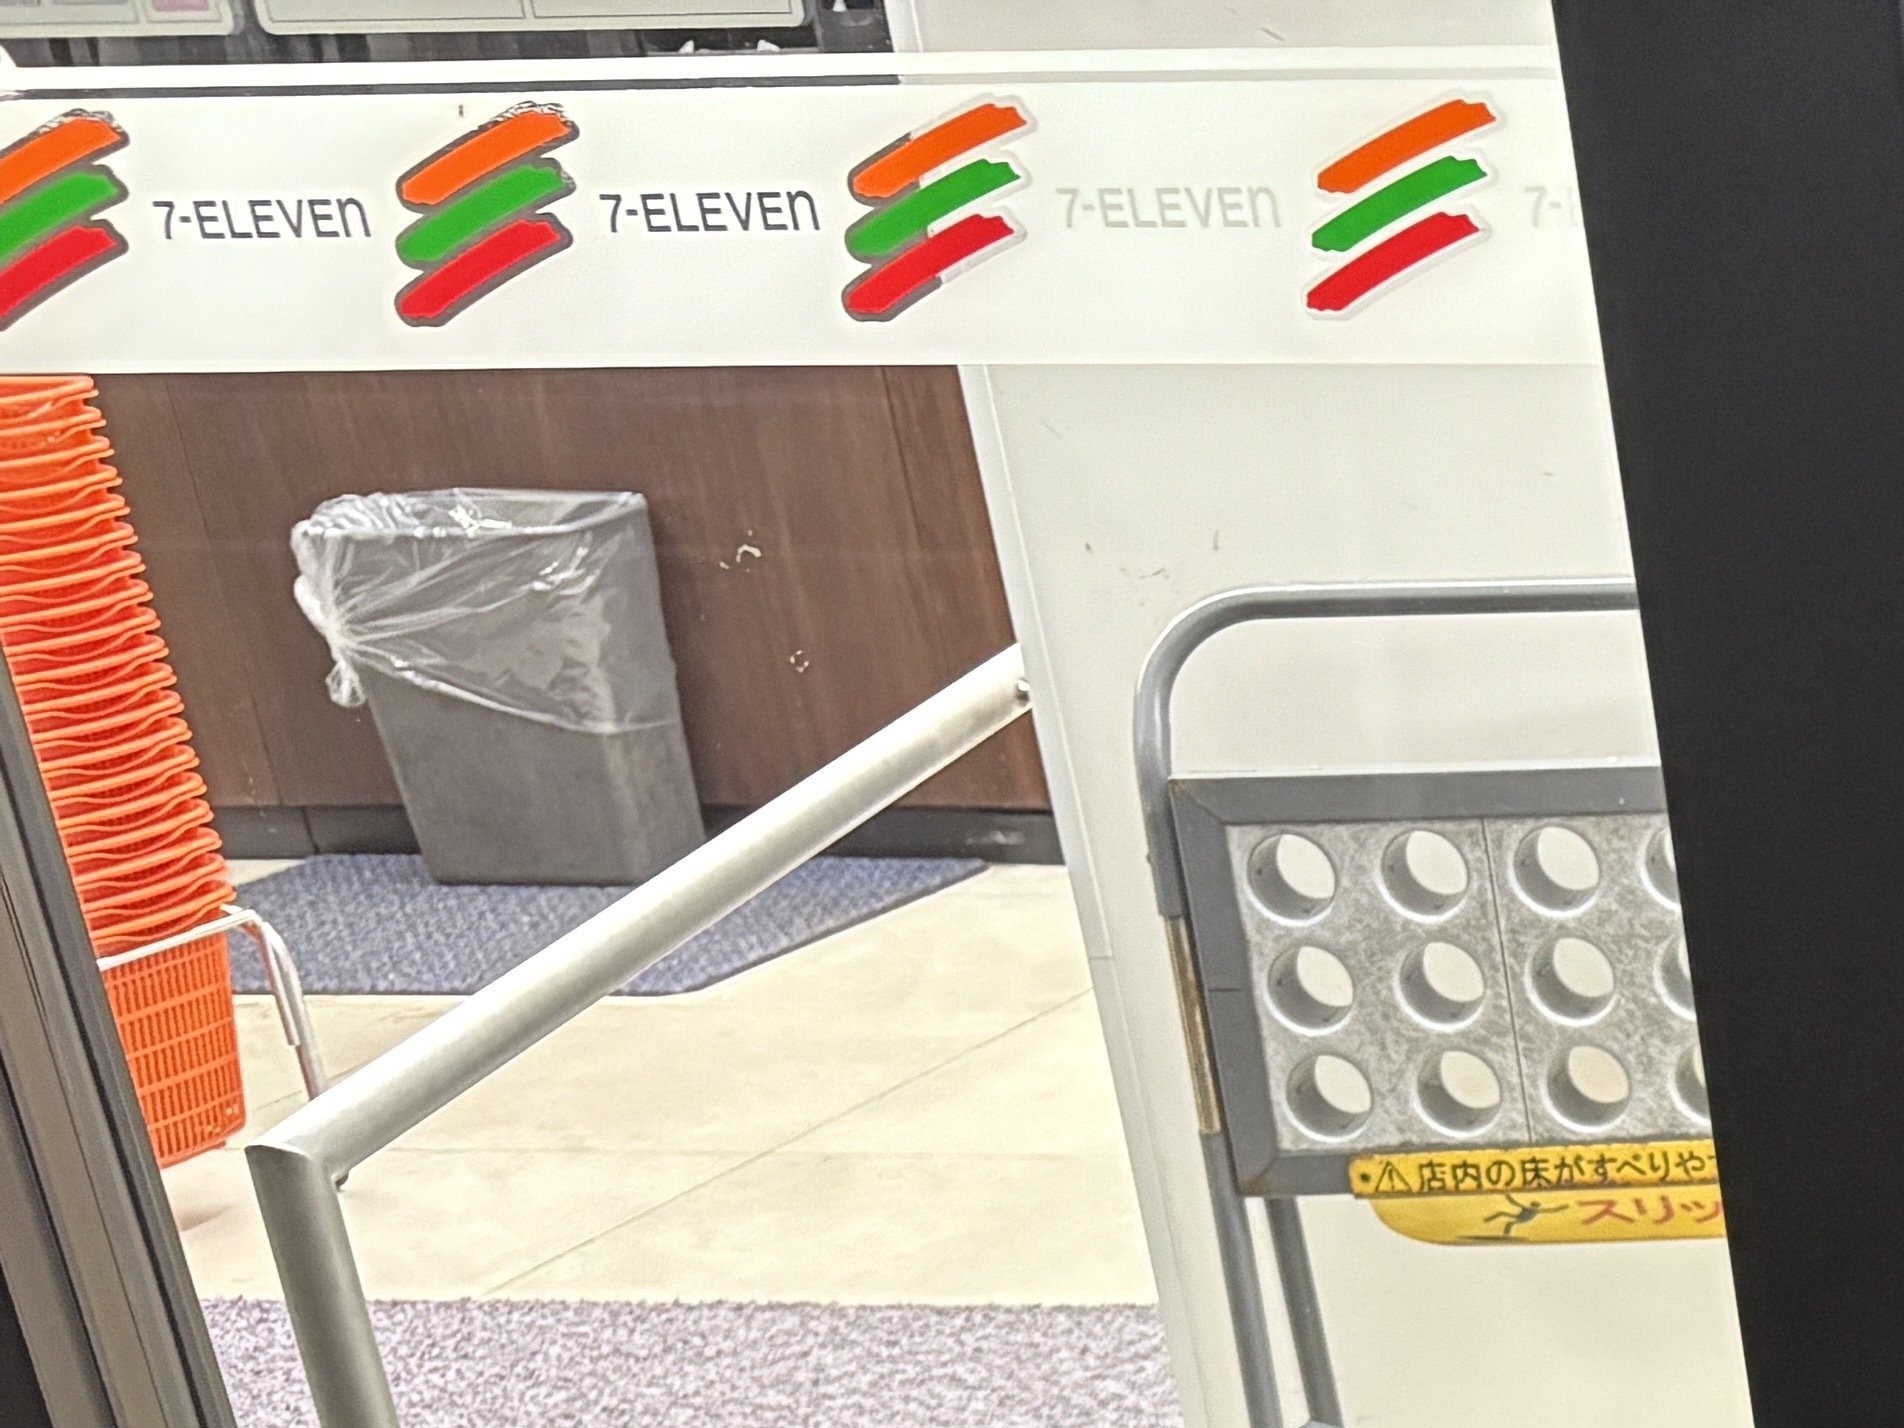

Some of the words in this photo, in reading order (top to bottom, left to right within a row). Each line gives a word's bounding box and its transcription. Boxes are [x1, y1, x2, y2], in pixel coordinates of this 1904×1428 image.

[152, 196, 372, 241] 7-ELEVEn
[598, 189, 821, 234] 7-ELEVEn
[1417, 1151, 1717, 1193] 店内の床がすべりや
